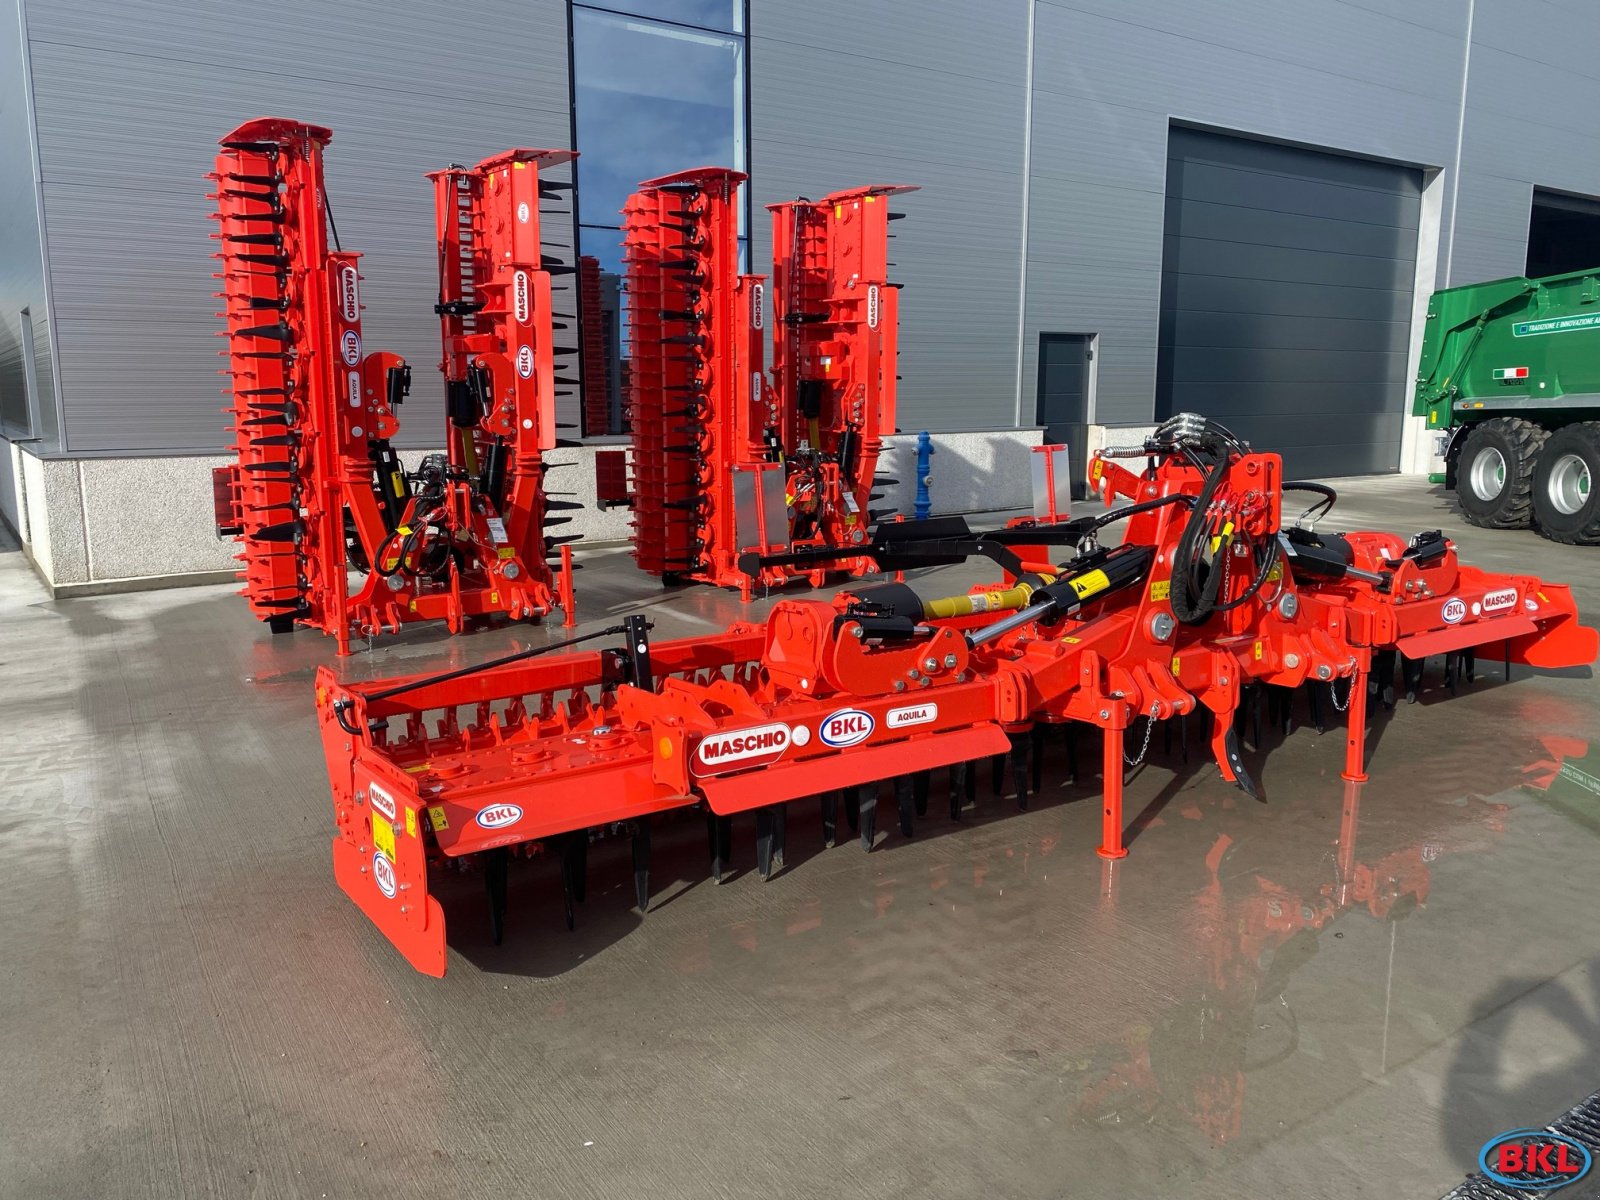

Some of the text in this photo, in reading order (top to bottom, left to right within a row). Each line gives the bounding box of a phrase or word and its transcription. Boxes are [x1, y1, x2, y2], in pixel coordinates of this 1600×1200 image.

[345, 269, 355, 319] MASCHIO
[517, 273, 525, 320] MASCHIO
[348, 337, 356, 361] BKL
[521, 350, 529, 372] BKL
[1446, 604, 1464, 616] BKL
[1485, 593, 1516, 607] MASCHIO
[830, 716, 867, 737] BKL
[897, 709, 928, 722] AQUILA
[704, 730, 786, 760] MASCHIO
[371, 787, 394, 814] MASCHIO
[485, 806, 518, 823] BKL
[377, 861, 394, 889] BKL
